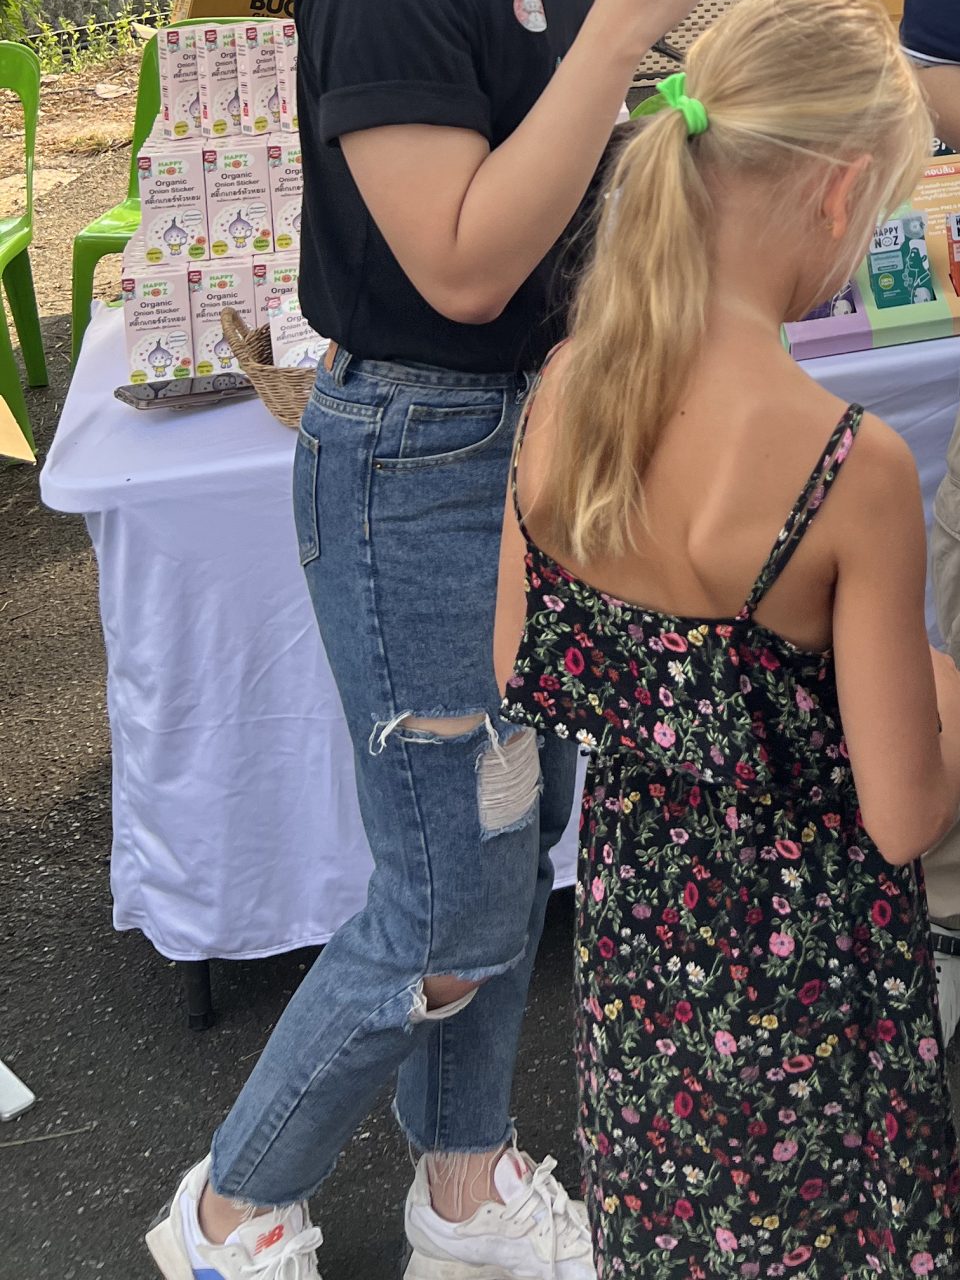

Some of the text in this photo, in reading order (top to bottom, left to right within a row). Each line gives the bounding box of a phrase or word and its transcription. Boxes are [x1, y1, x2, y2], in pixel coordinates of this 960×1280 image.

[221, 172, 252, 180] Organic
[155, 179, 187, 187] Organic
[873, 225, 899, 238] HAPPY
[206, 292, 238, 301] Organic
[140, 300, 172, 309] Organic
